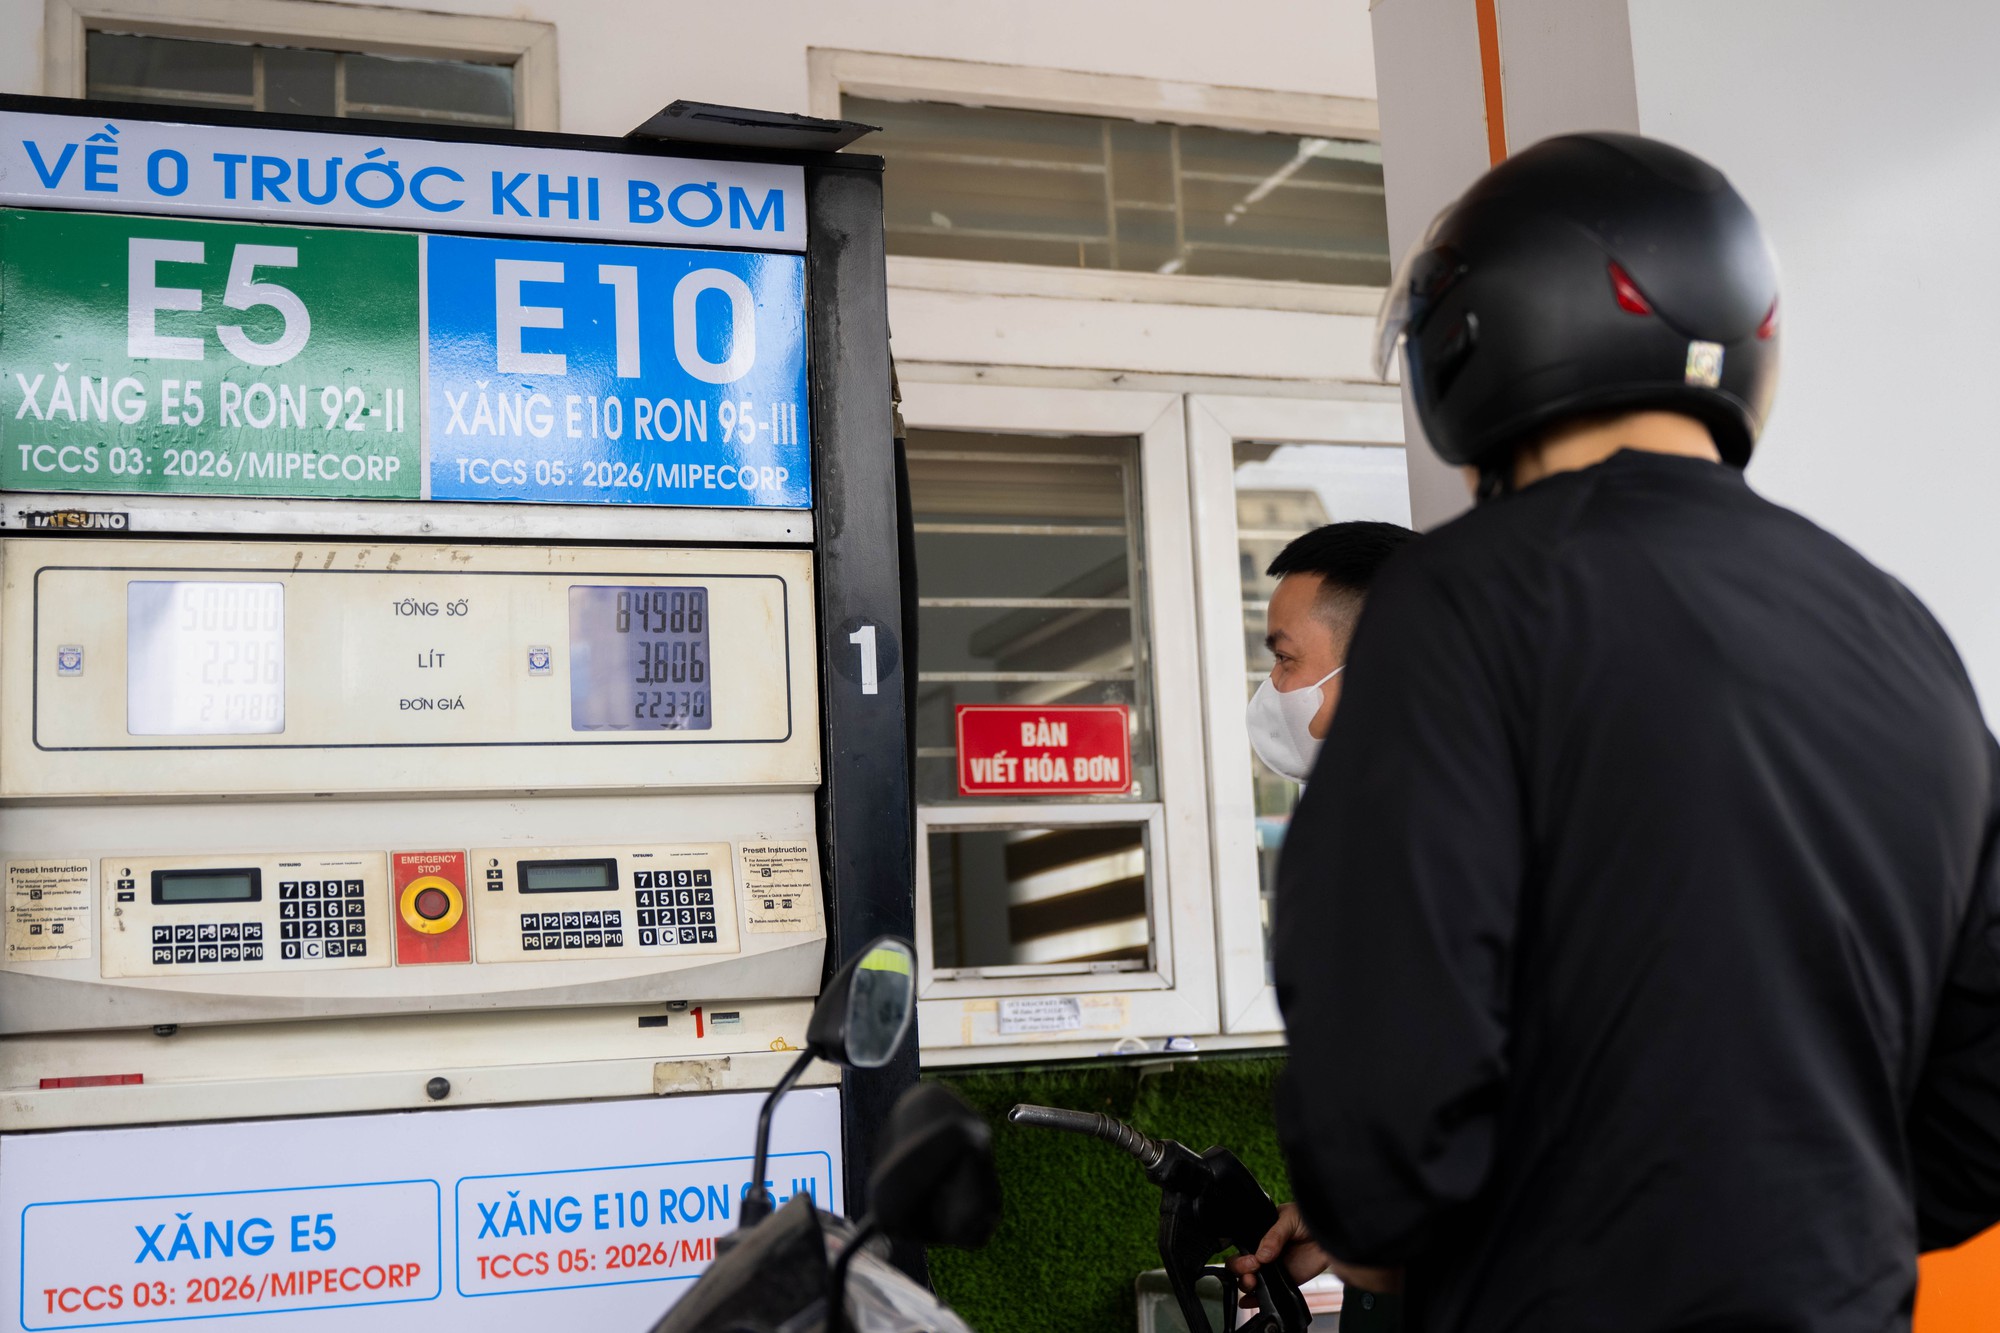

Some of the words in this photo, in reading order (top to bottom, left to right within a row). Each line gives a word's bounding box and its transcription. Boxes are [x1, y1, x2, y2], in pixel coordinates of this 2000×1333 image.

[22, 123, 120, 192] VỀ
[213, 147, 465, 212] TRƯỚC
[492, 171, 600, 221] KHI
[628, 180, 785, 232] BƠM
[127, 237, 311, 366] E5
[495, 258, 757, 384] E10
[15, 362, 147, 425] XĂNG
[162, 380, 205, 427] E5
[220, 382, 306, 430] RON
[320, 385, 404, 433] 92-II
[444, 380, 554, 438] XĂNG
[566, 395, 623, 441] E10
[634, 397, 708, 442] RON
[718, 400, 798, 446] 95-III
[18, 444, 99, 474] TCCS
[109, 447, 152, 475] 03:
[163, 449, 401, 481] 2026/MIPECORP
[456, 458, 527, 485] TCCS
[535, 459, 573, 486] 05:
[582, 460, 789, 492] 2026/MIPECORP
[393, 598, 439, 616] TỔNG
[446, 598, 469, 616] SỐ
[418, 649, 445, 668] LÍT
[849, 625, 878, 695] 1
[400, 697, 434, 711] ĐƠN
[437, 695, 465, 711] GIÁ
[635, 690, 704, 718] 22330
[1021, 717, 1068, 748] BÀN
[970, 750, 1019, 784] VIẾT
[1023, 753, 1069, 783] HÓA
[1073, 754, 1120, 783] ĐƠN
[401, 855, 456, 864] EMERGENCY
[41, 865, 88, 873] Instruction
[418, 865, 442, 874] STOP
[638, 874, 648, 886] 7
[658, 873, 668, 886] 8
[678, 872, 687, 885] 9
[696, 874, 707, 882] F1
[284, 884, 294, 897] 7
[306, 883, 316, 896] 8
[327, 882, 338, 896] 9
[348, 884, 359, 893] F1
[640, 893, 650, 905] 4
[660, 892, 669, 905] 5
[680, 891, 689, 904] 6
[698, 893, 710, 901] F2
[284, 904, 295, 917] 4
[306, 903, 317, 917] 5
[328, 902, 338, 916] 6
[348, 904, 362, 913] F2
[642, 912, 649, 924] 1
[661, 911, 671, 924] 2
[681, 910, 691, 923] 3
[700, 912, 712, 920] F3
[286, 924, 293, 937] 1
[307, 923, 317, 936] 2
[329, 922, 339, 936] 3
[349, 924, 362, 933] F3
[523, 917, 537, 927] P1
[543, 916, 559, 927] P2
[564, 916, 579, 926] P3
[584, 915, 599, 925] P4
[605, 914, 619, 924] P5
[154, 930, 170, 940] P1
[177, 929, 194, 939] P2
[222, 927, 238, 938] P4
[244, 926, 261, 937] P5
[524, 937, 539, 947] P6
[545, 936, 560, 946] P7
[565, 935, 581, 945] P8
[586, 934, 601, 944] P9
[605, 933, 622, 944] P10
[662, 930, 674, 943] C
[702, 931, 713, 939] F4
[154, 950, 171, 961] P6
[177, 949, 194, 960] P7
[200, 949, 216, 959] P8
[222, 948, 239, 958] P9
[243, 946, 263, 957] P10
[307, 943, 319, 957] C
[350, 944, 363, 953] F4
[690, 1006, 704, 1038] 1
[477, 1190, 583, 1240] XĂNG
[594, 1190, 649, 1232] E10
[660, 1184, 730, 1225] RON
[134, 1211, 275, 1264] XĂNG
[291, 1213, 336, 1252] E5
[477, 1251, 549, 1281] TCCS
[557, 1248, 596, 1274] 05:
[43, 1284, 123, 1314] TCCS
[133, 1281, 176, 1308] 03:
[186, 1262, 421, 1303] 2026/MIPECORP
